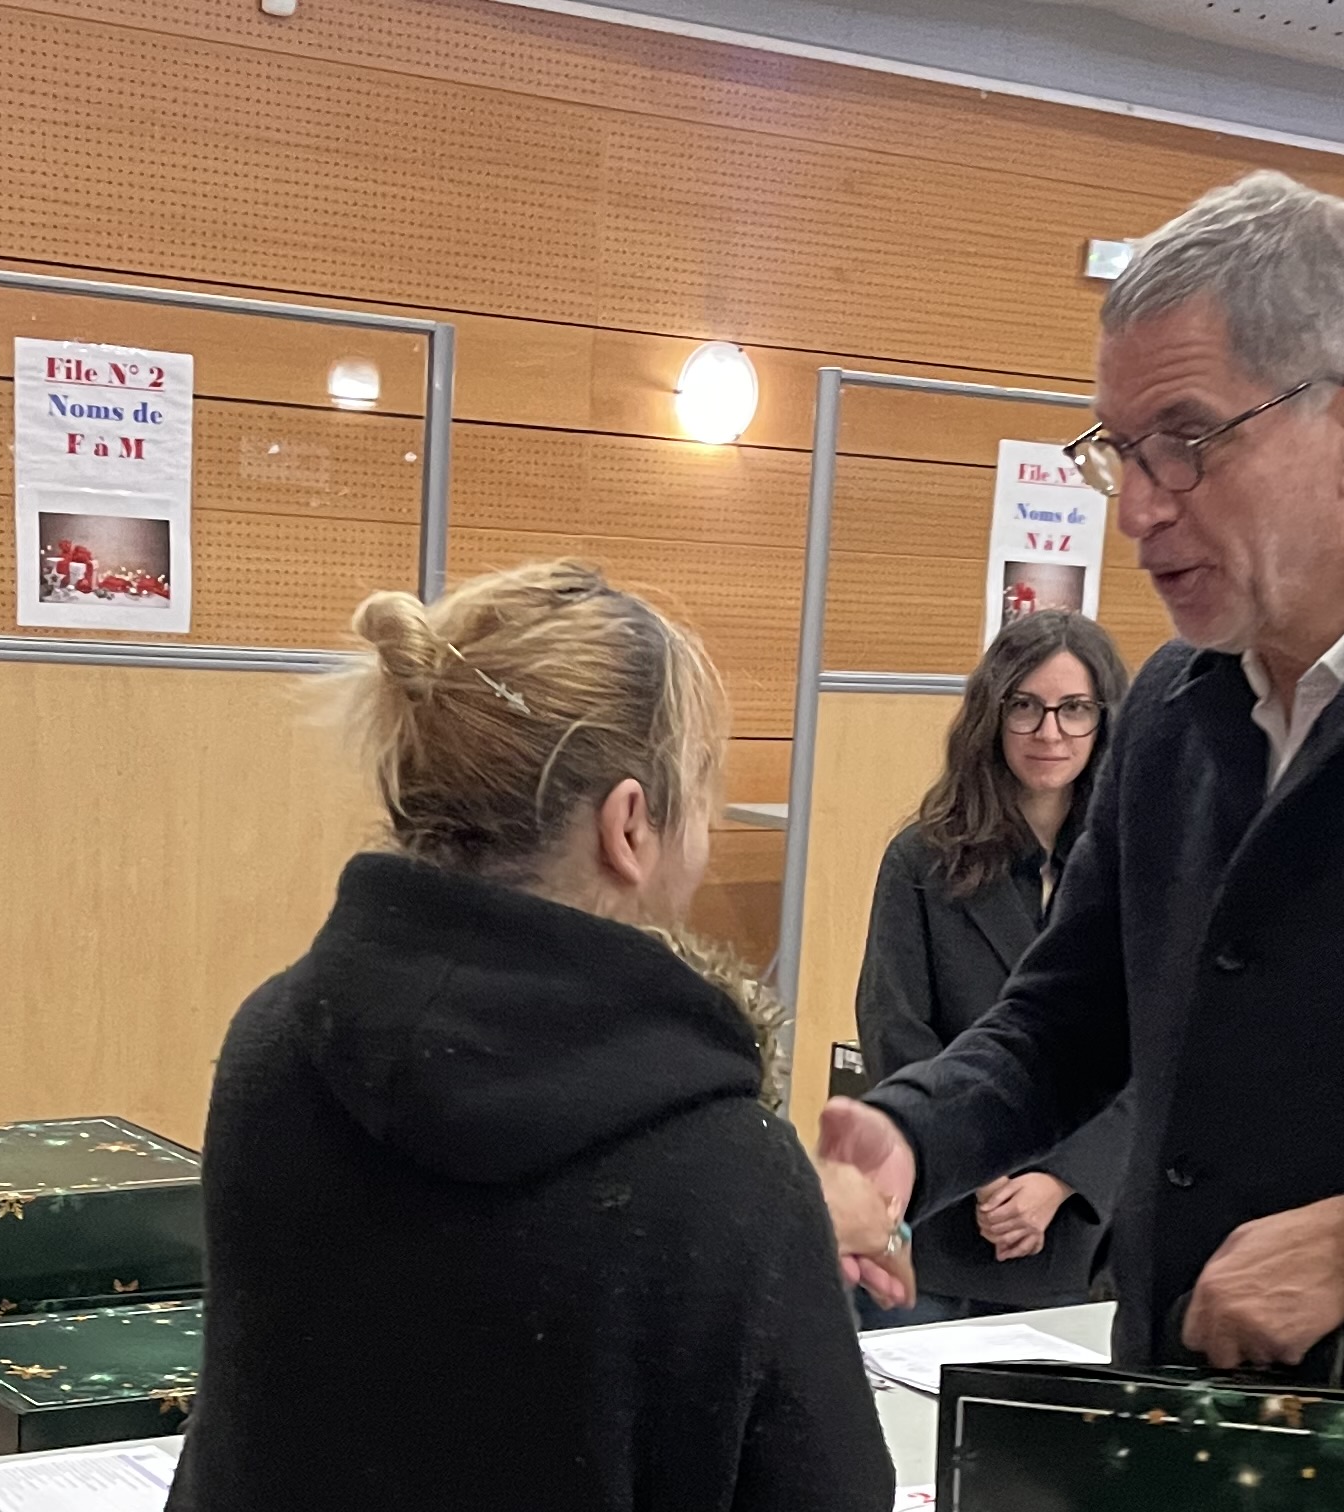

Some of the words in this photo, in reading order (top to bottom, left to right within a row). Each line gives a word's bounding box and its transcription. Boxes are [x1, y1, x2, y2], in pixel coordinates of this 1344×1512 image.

[46, 356, 98, 382] File
[107, 362, 140, 385] N°
[148, 365, 165, 388] 2
[47, 393, 125, 421] Noms
[133, 401, 164, 425] de
[66, 432, 85, 455] F
[93, 435, 109, 457] à
[118, 437, 146, 460] M
[1017, 463, 1051, 482] File
[1013, 502, 1063, 524] Noms
[1067, 507, 1087, 525] de
[1024, 531, 1041, 550] N
[1043, 534, 1054, 551] à
[1058, 534, 1072, 552] Z
